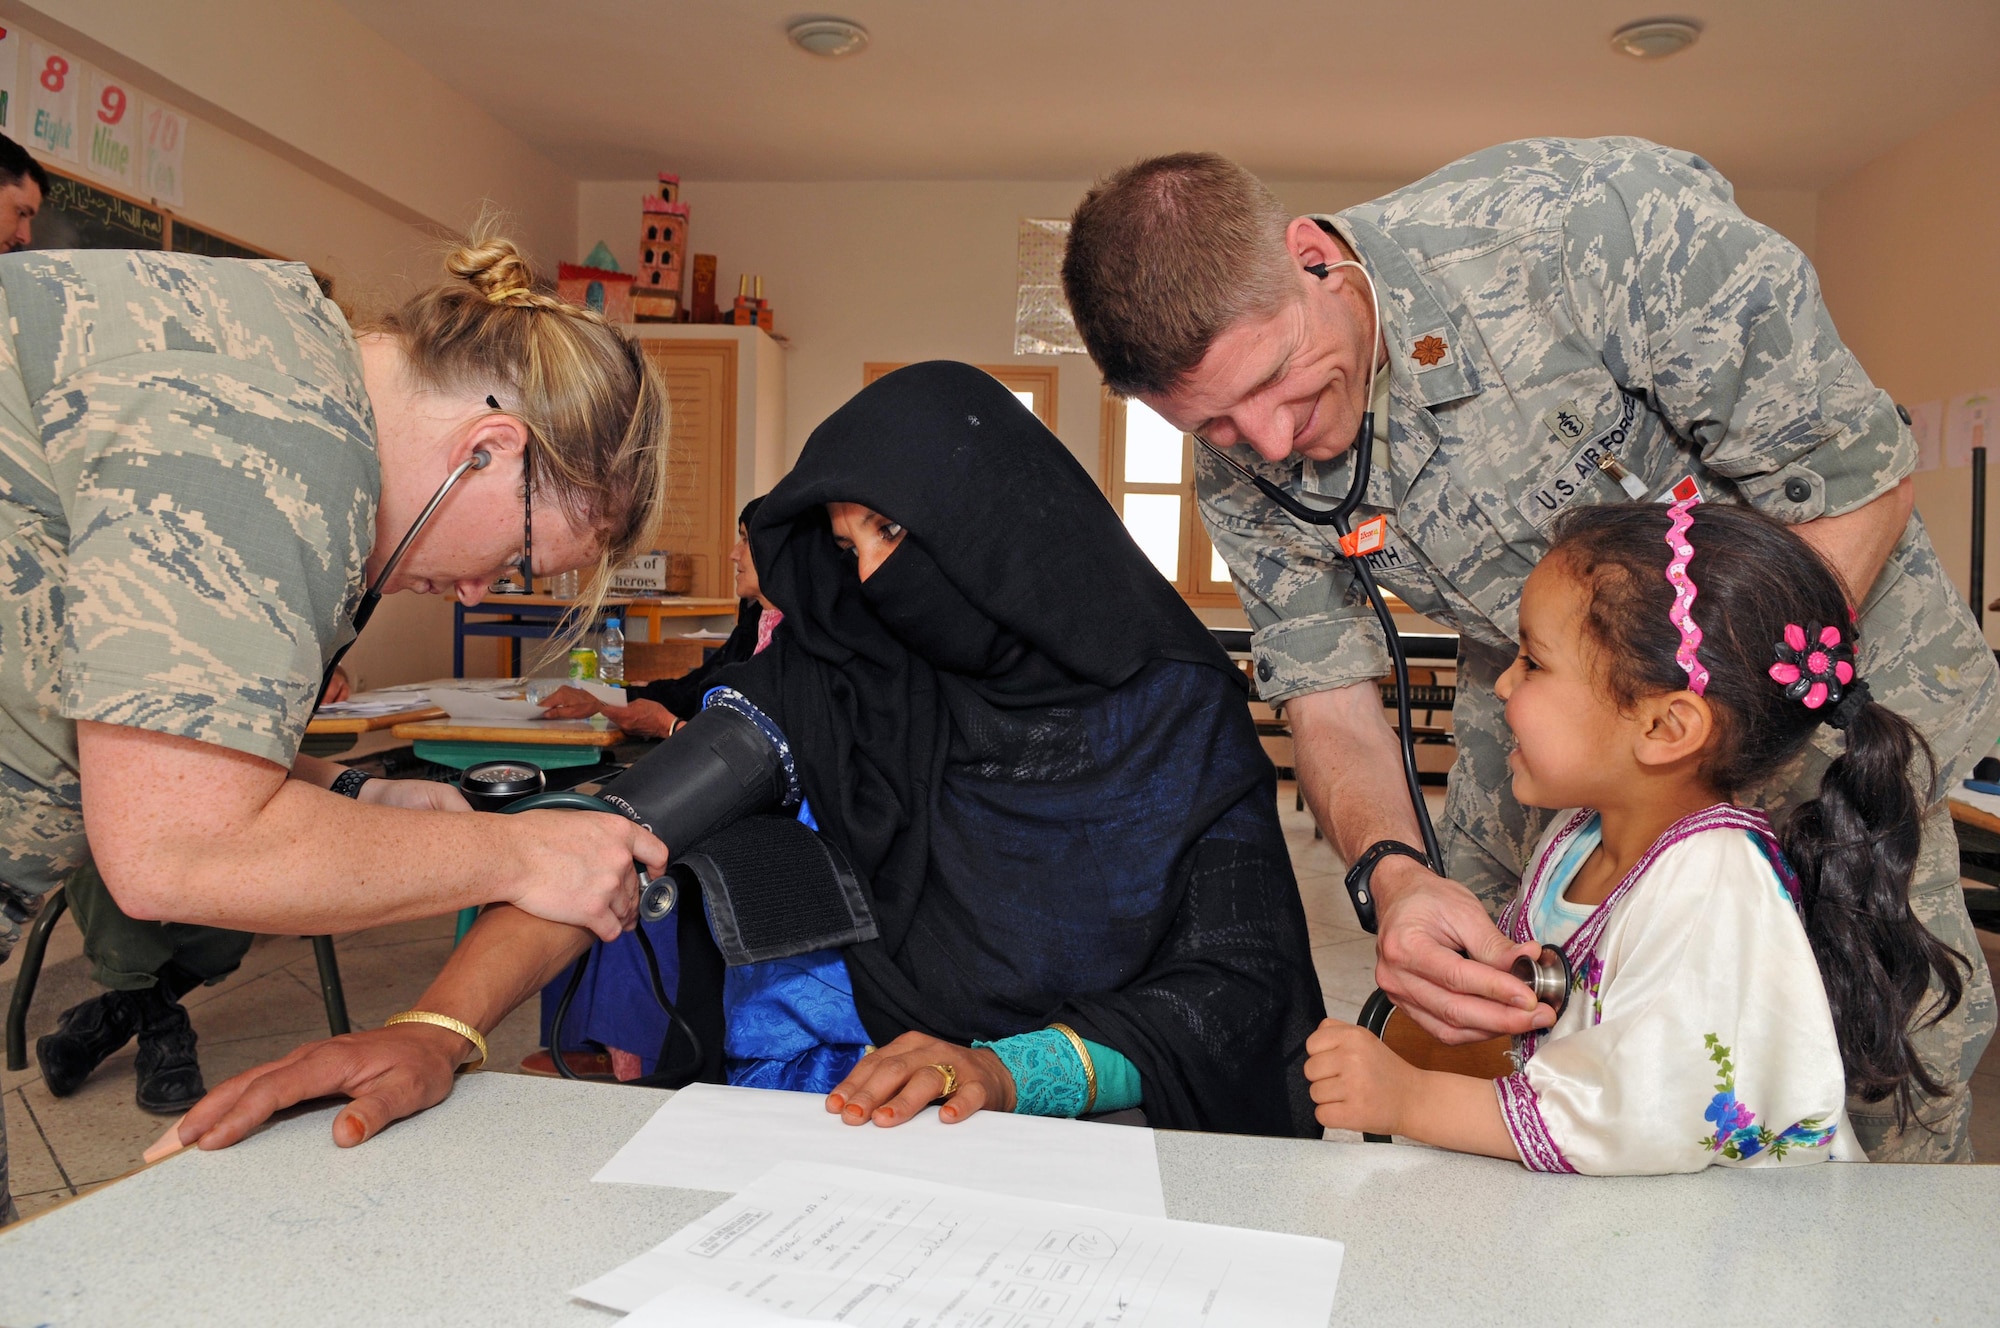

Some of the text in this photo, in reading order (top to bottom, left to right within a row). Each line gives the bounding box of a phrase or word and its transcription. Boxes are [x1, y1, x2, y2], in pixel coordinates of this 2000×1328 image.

[40, 55, 69, 92] 8
[97, 85, 127, 125] 9
[34, 108, 73, 151] Eight
[92, 122, 130, 175] Nine
[149, 108, 178, 152] 10
[1535, 392, 1636, 511] U.S. AIR FORCE
[643, 557, 659, 570] of
[1365, 545, 1402, 569] RTH
[614, 574, 657, 588] heroes
[603, 794, 641, 821] ARTERY
